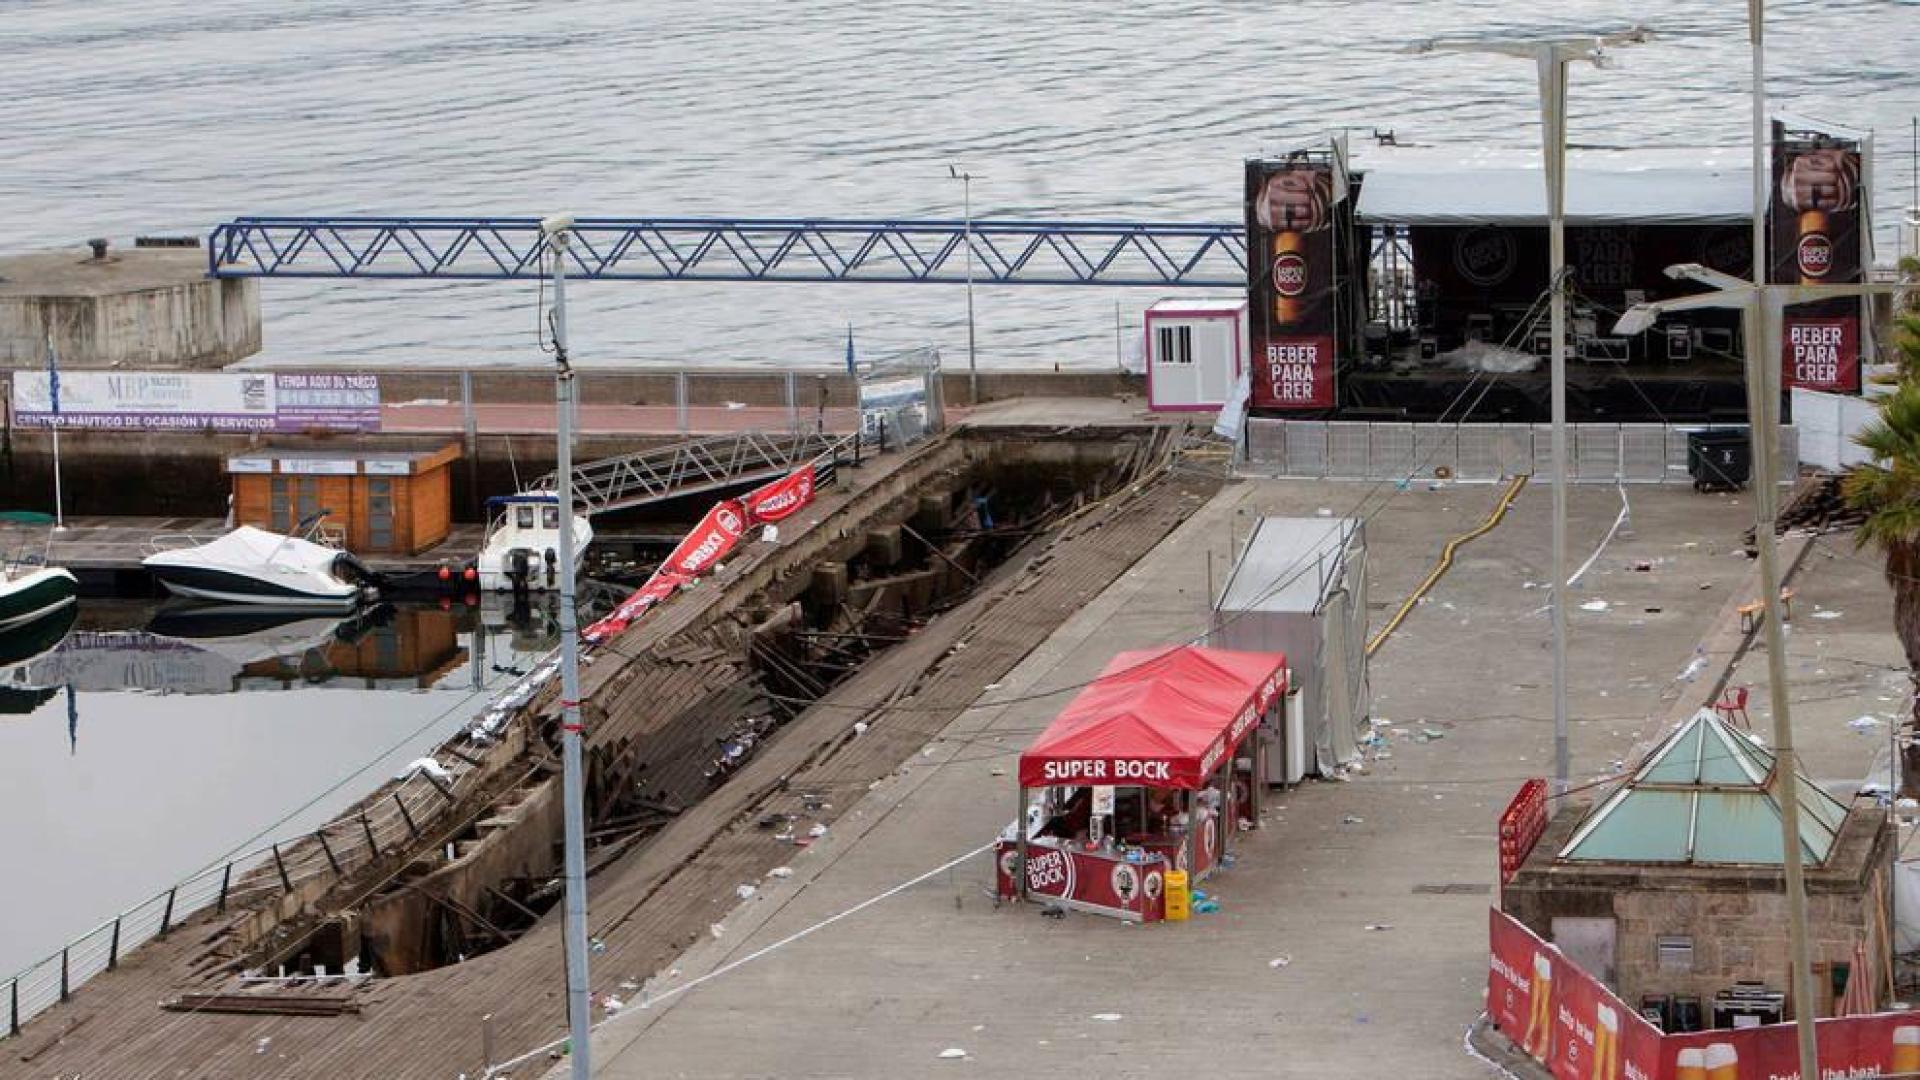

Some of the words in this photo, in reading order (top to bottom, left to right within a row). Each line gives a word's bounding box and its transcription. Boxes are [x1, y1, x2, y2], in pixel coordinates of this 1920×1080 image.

[1579, 242, 1634, 263] PARA
[1803, 254, 1828, 264] BOCK
[1581, 263, 1632, 284] CRER
[1791, 327, 1842, 345] BEBER
[1267, 346, 1318, 363] BEBER
[1795, 346, 1838, 363] PARA
[1272, 364, 1314, 382] PARA
[1796, 364, 1838, 382] CRER
[1273, 382, 1313, 400] CRER
[126, 416, 140, 427] DE
[143, 415, 198, 428] OCASIÓN
[200, 417, 208, 427] Y
[213, 418, 275, 429] SERVICIOS
[1044, 760, 1106, 779] SUPER
[1115, 760, 1170, 780] BOCK
[1027, 851, 1063, 875] SUPER
[1031, 867, 1065, 889] BOCK
